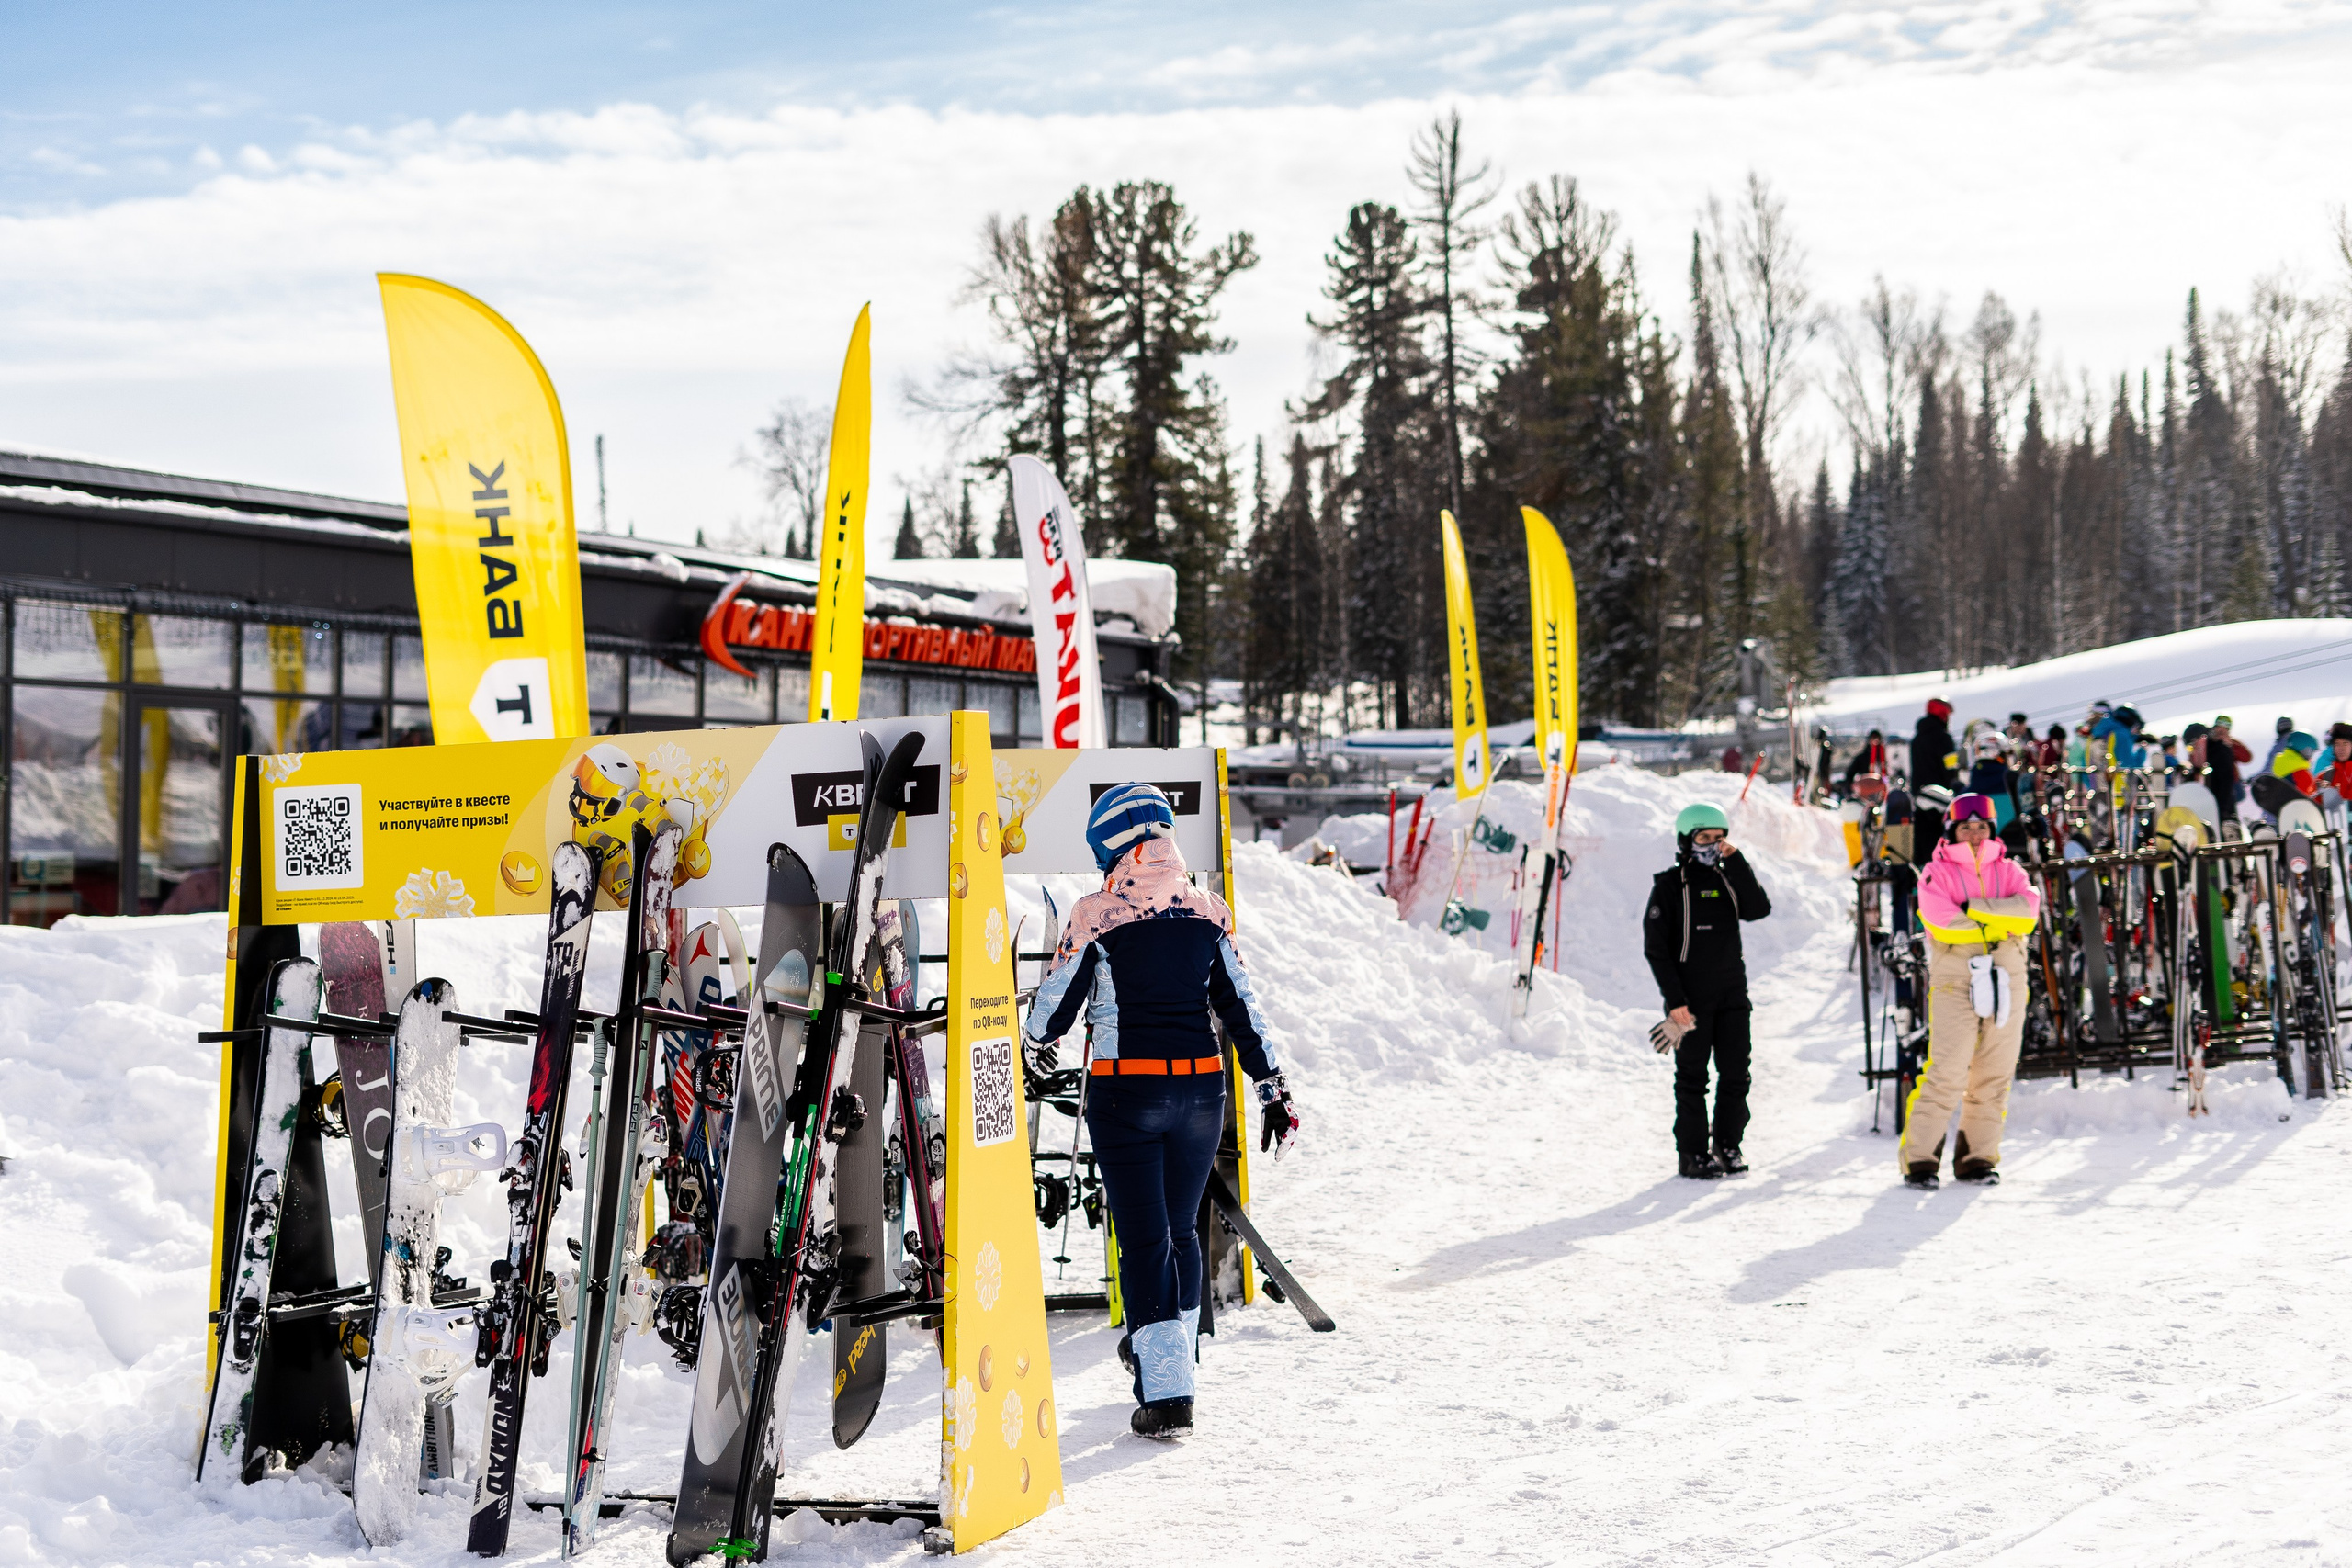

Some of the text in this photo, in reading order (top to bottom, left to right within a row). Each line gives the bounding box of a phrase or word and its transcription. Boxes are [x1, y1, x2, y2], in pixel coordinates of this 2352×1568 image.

[727, 602, 816, 653] КАН
[379, 795, 511, 811] Участвуйте в квесте
[813, 781, 918, 807] КВТ
[379, 813, 509, 831] и получайте призы!
[387, 920, 396, 964] HEA
[970, 994, 1009, 1010] Переходите
[973, 1014, 1008, 1030] по QR-коду
[749, 1013, 781, 1132] PRIME
[721, 1275, 752, 1393] PRIME
[424, 1416, 438, 1472] AMBITION
[486, 1395, 513, 1520] NOMAD 164
[473, 1475, 483, 1506] SMOKE
